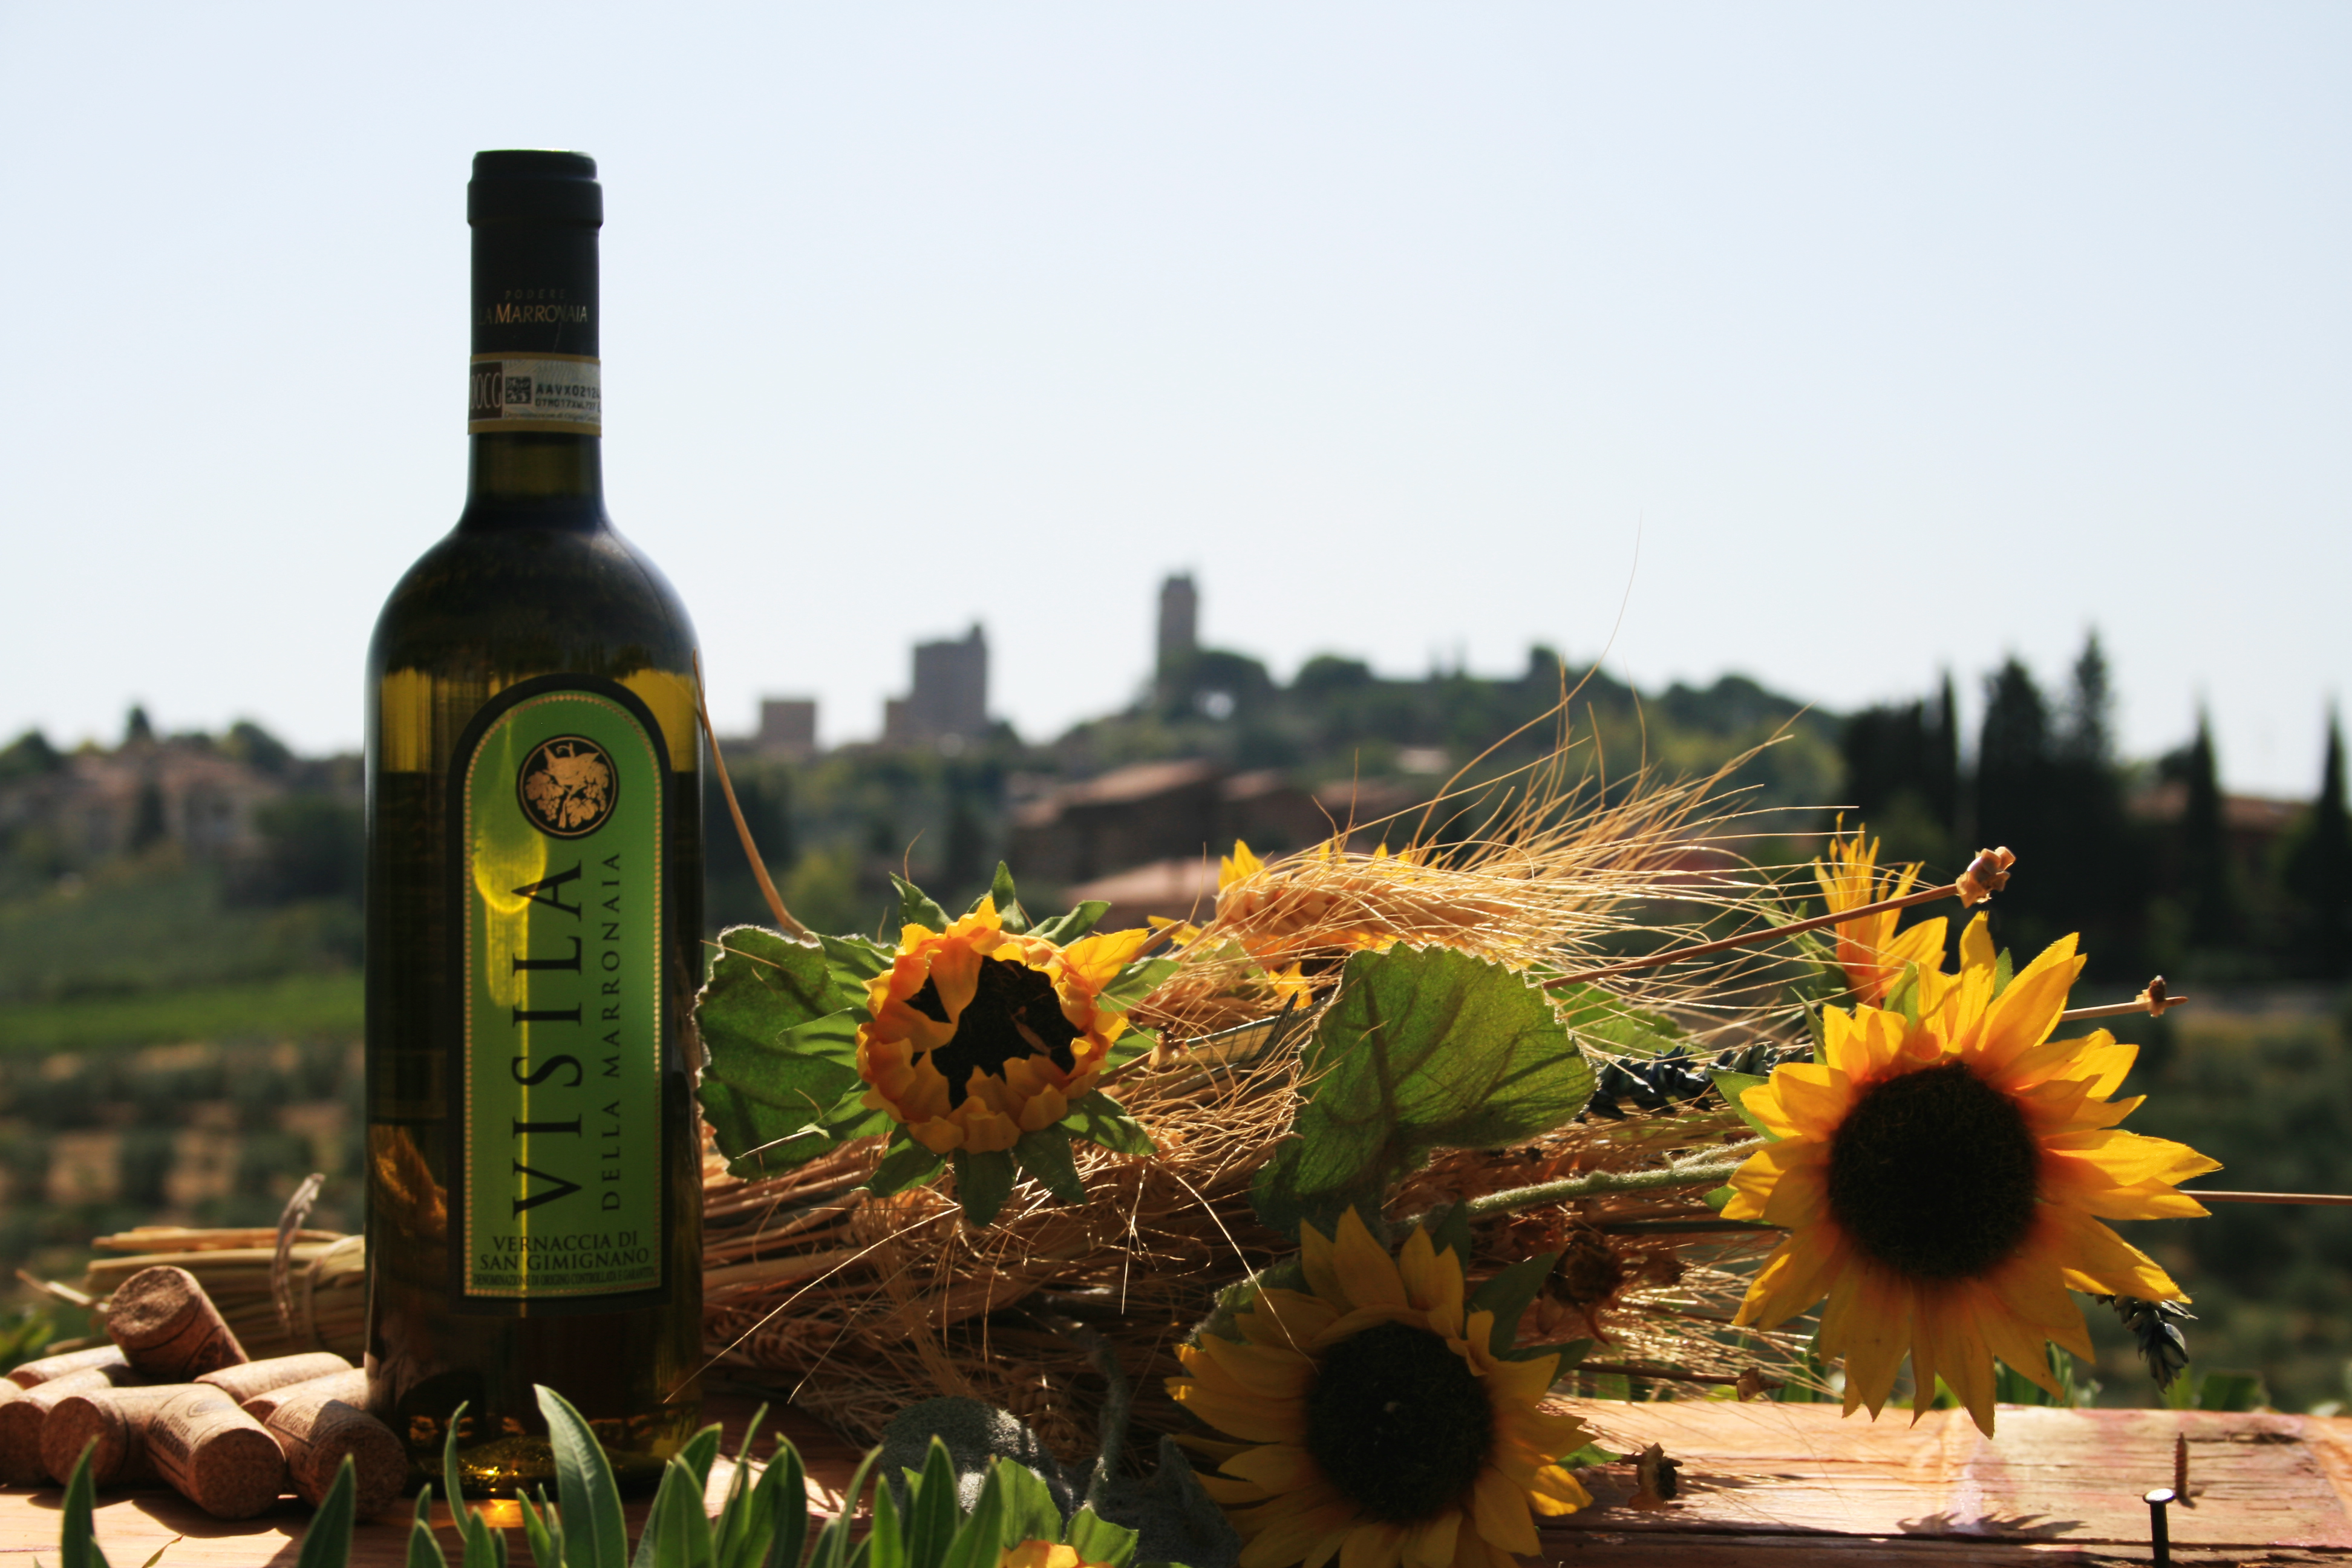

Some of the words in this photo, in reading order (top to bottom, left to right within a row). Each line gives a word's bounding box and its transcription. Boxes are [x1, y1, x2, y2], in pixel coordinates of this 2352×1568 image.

[505, 289, 566, 300] PODERE
[601, 854, 620, 1078] MARRONAIA
[511, 859, 583, 1220] VISILA
[602, 1100, 620, 1212] DELLA
[480, 1254, 518, 1270] SAN
[526, 1247, 649, 1270] GIMIGNANO
[492, 1233, 612, 1252] VERNACCIA
[618, 1230, 638, 1247] DI
